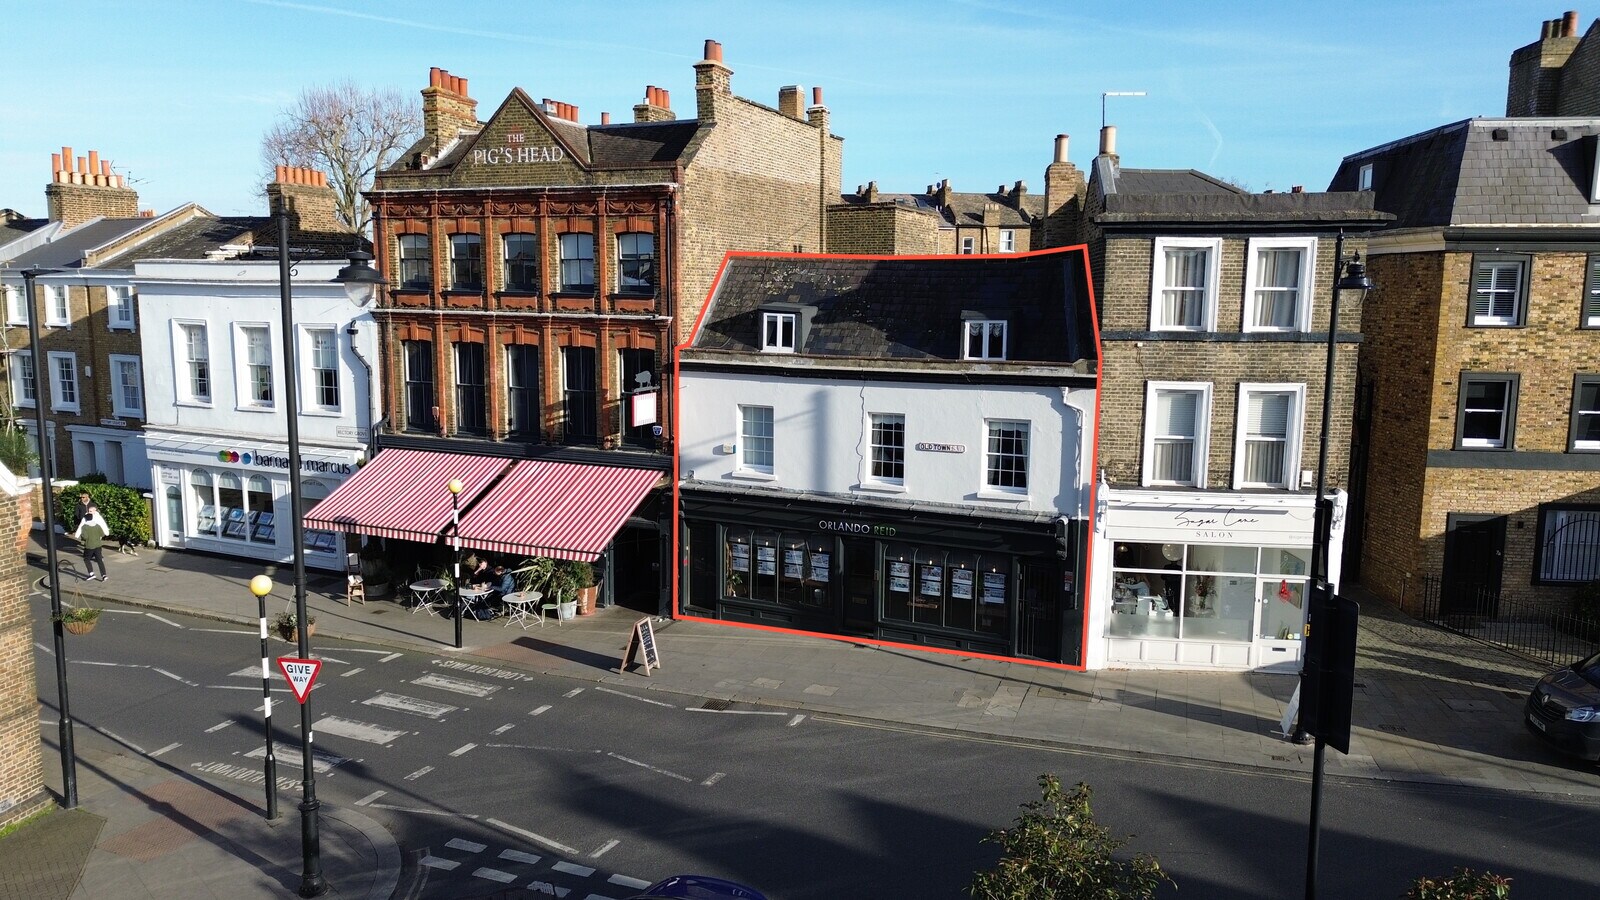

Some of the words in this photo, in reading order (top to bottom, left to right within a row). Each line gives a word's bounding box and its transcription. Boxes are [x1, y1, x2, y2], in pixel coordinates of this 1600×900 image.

[507, 134, 525, 143] THE
[473, 147, 513, 165] PIG'S
[517, 146, 564, 163] HEAD
[253, 449, 302, 470] barna
[306, 458, 351, 475] marcus
[1174, 508, 1218, 527] Sugar
[818, 520, 870, 534] ORLANDO
[873, 525, 897, 537] REID
[1195, 531, 1234, 539] SALON
[286, 664, 311, 674] GIVE
[292, 675, 308, 683] WAY
